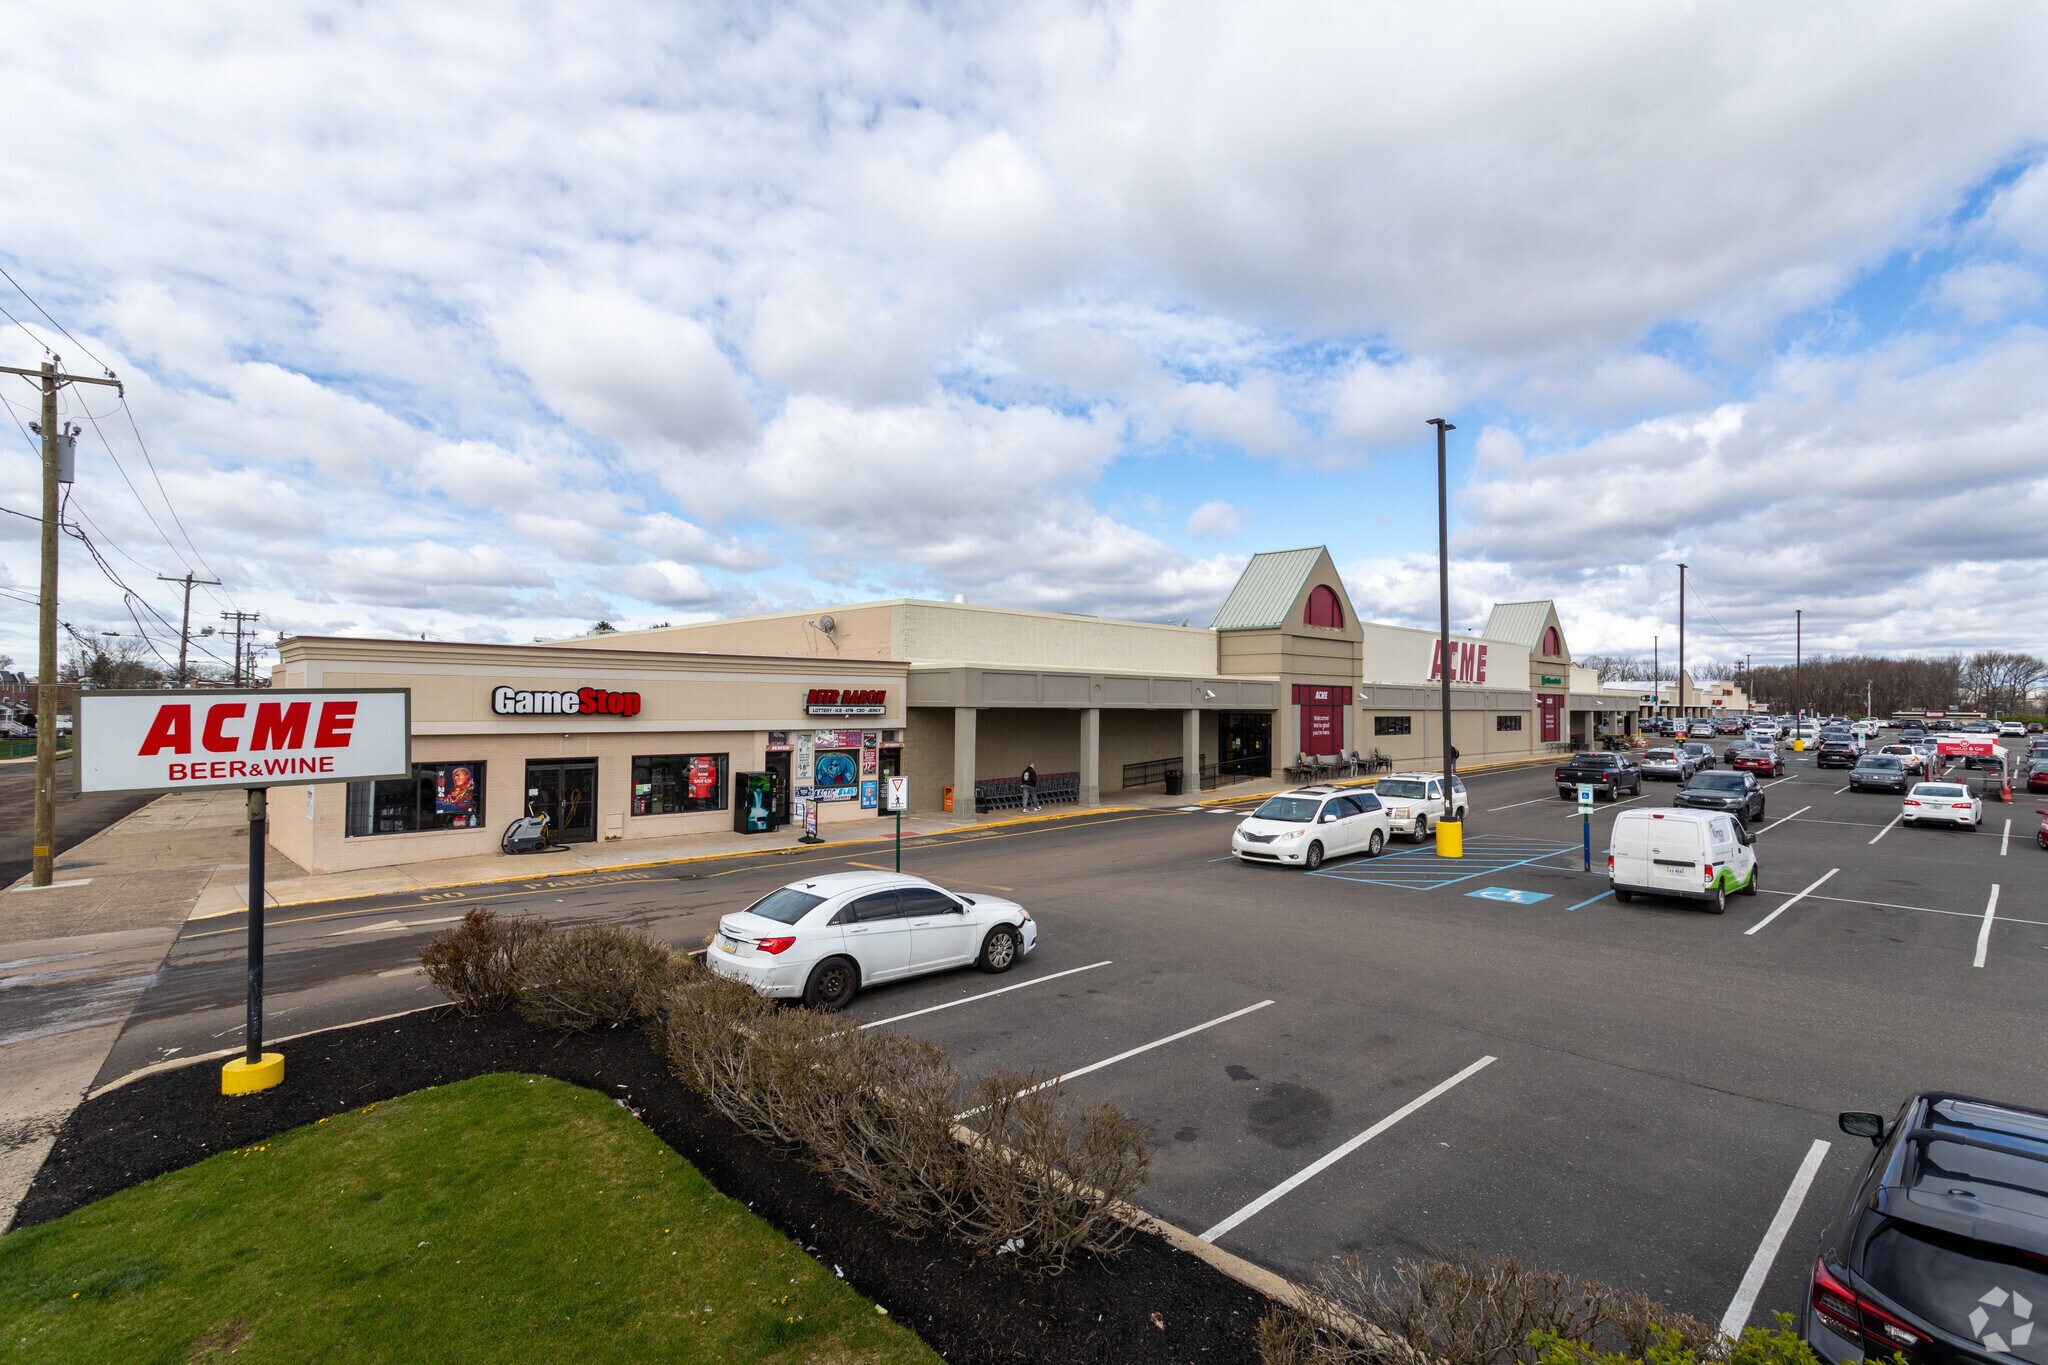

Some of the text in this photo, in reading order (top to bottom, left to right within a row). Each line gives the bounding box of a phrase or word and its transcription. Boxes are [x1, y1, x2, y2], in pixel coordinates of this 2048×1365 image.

[1428, 639, 1488, 683] ACME
[494, 686, 641, 718] GameStop
[807, 689, 887, 704] BEER BARON
[1315, 691, 1328, 700] ACME
[138, 701, 358, 756] ACME
[169, 756, 334, 781] BEER&WINE
[523, 872, 650, 890] PARKING
[419, 890, 467, 903] NO
